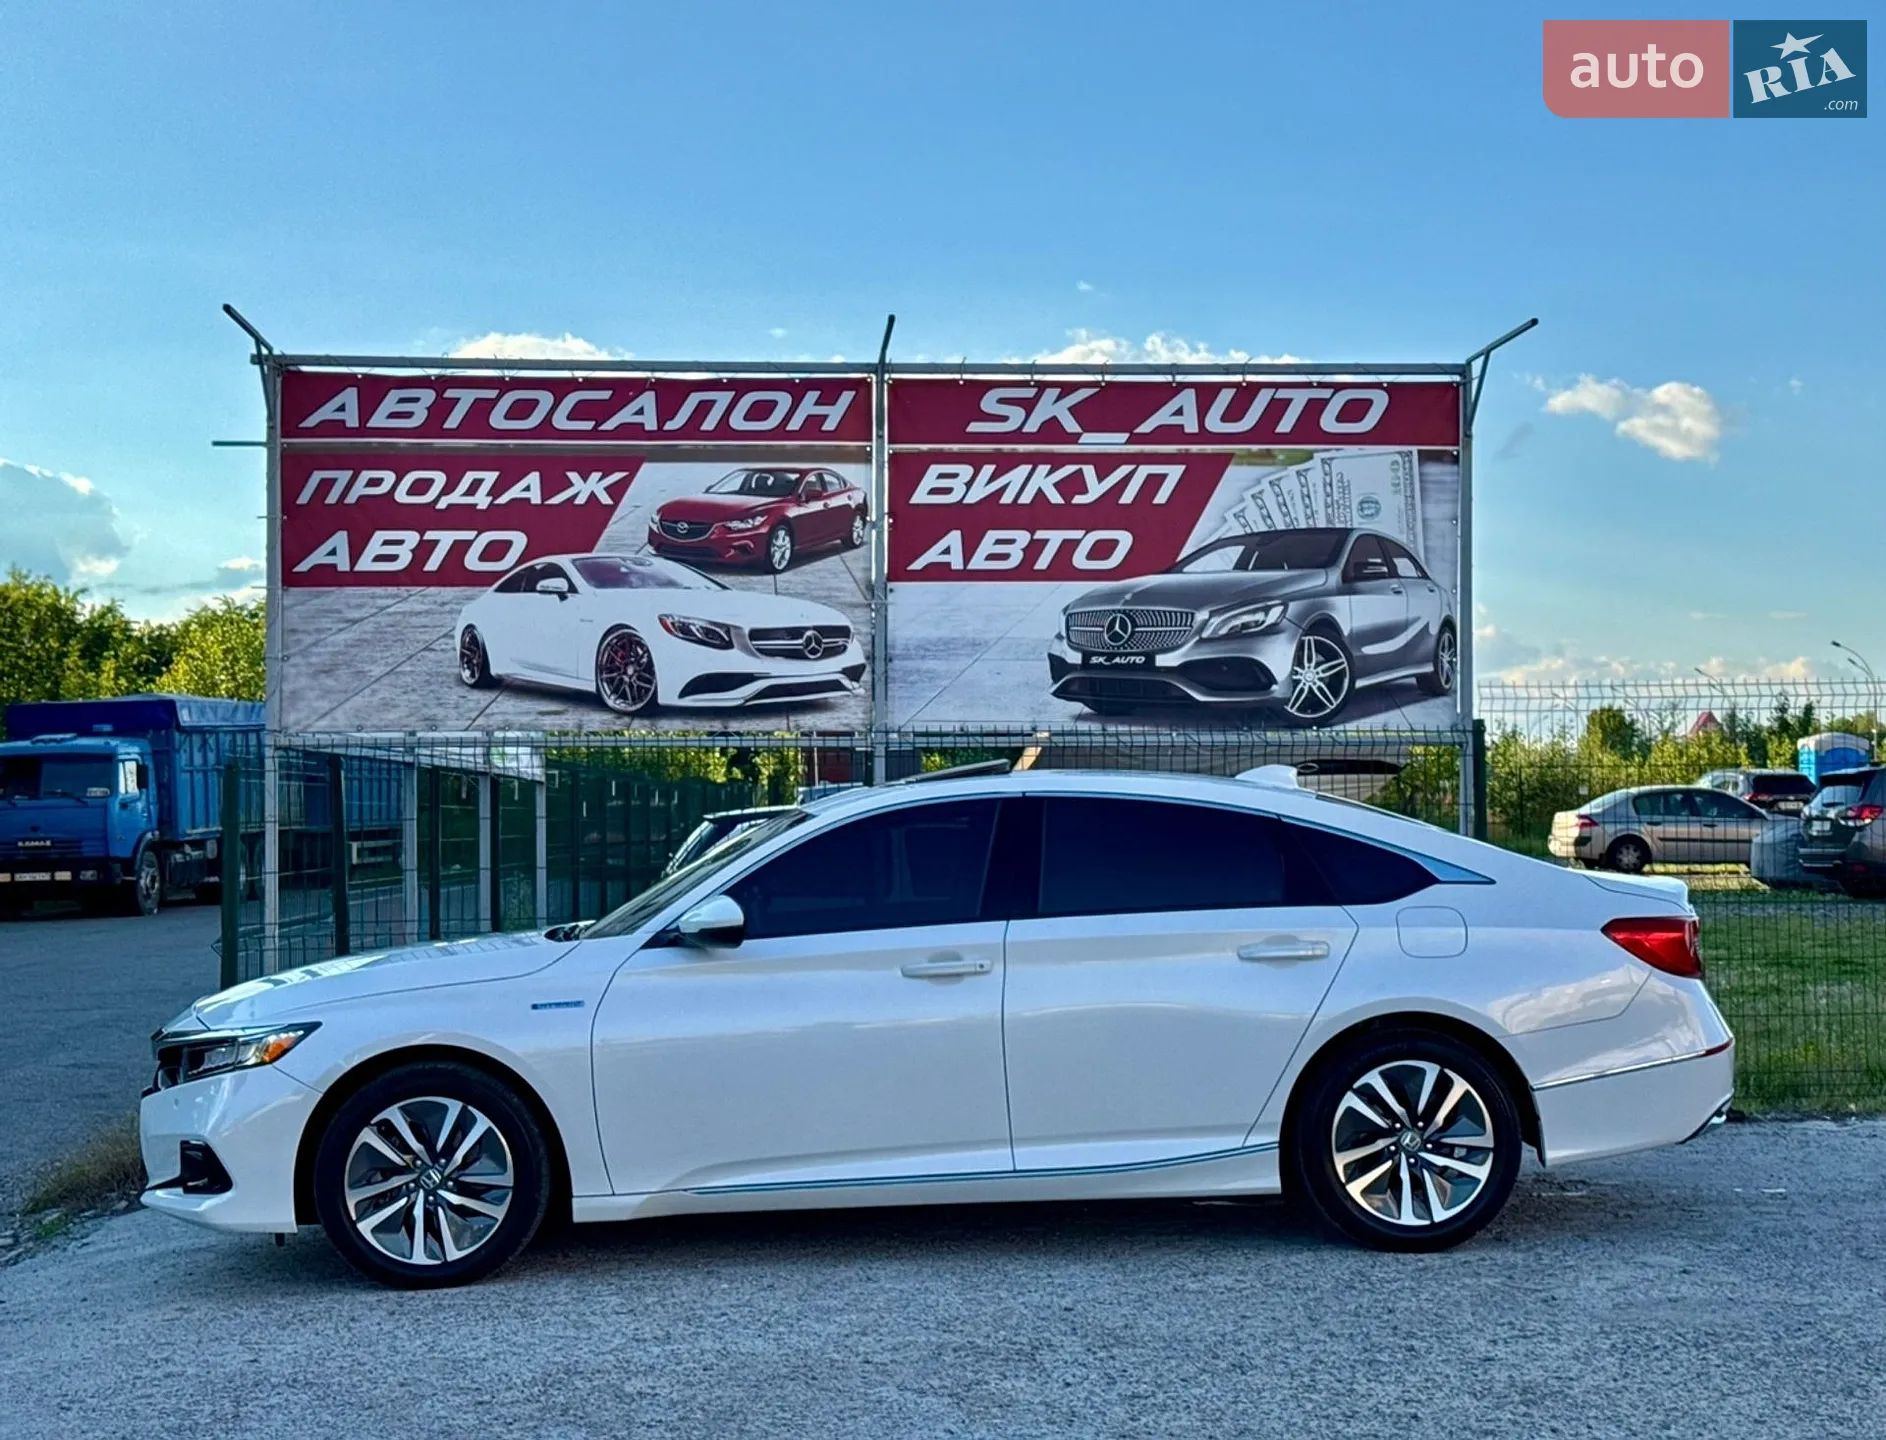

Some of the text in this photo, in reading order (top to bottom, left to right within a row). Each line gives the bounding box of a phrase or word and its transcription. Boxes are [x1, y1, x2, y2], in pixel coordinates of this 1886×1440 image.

[299, 387, 857, 431] АВТОСАЛОН
[965, 387, 1389, 444] SK_AUTO
[296, 470, 629, 510] ПРОДАЖ
[909, 463, 1187, 505] ВИКУП
[292, 530, 528, 572] АВТО
[906, 529, 1134, 571] АВТО
